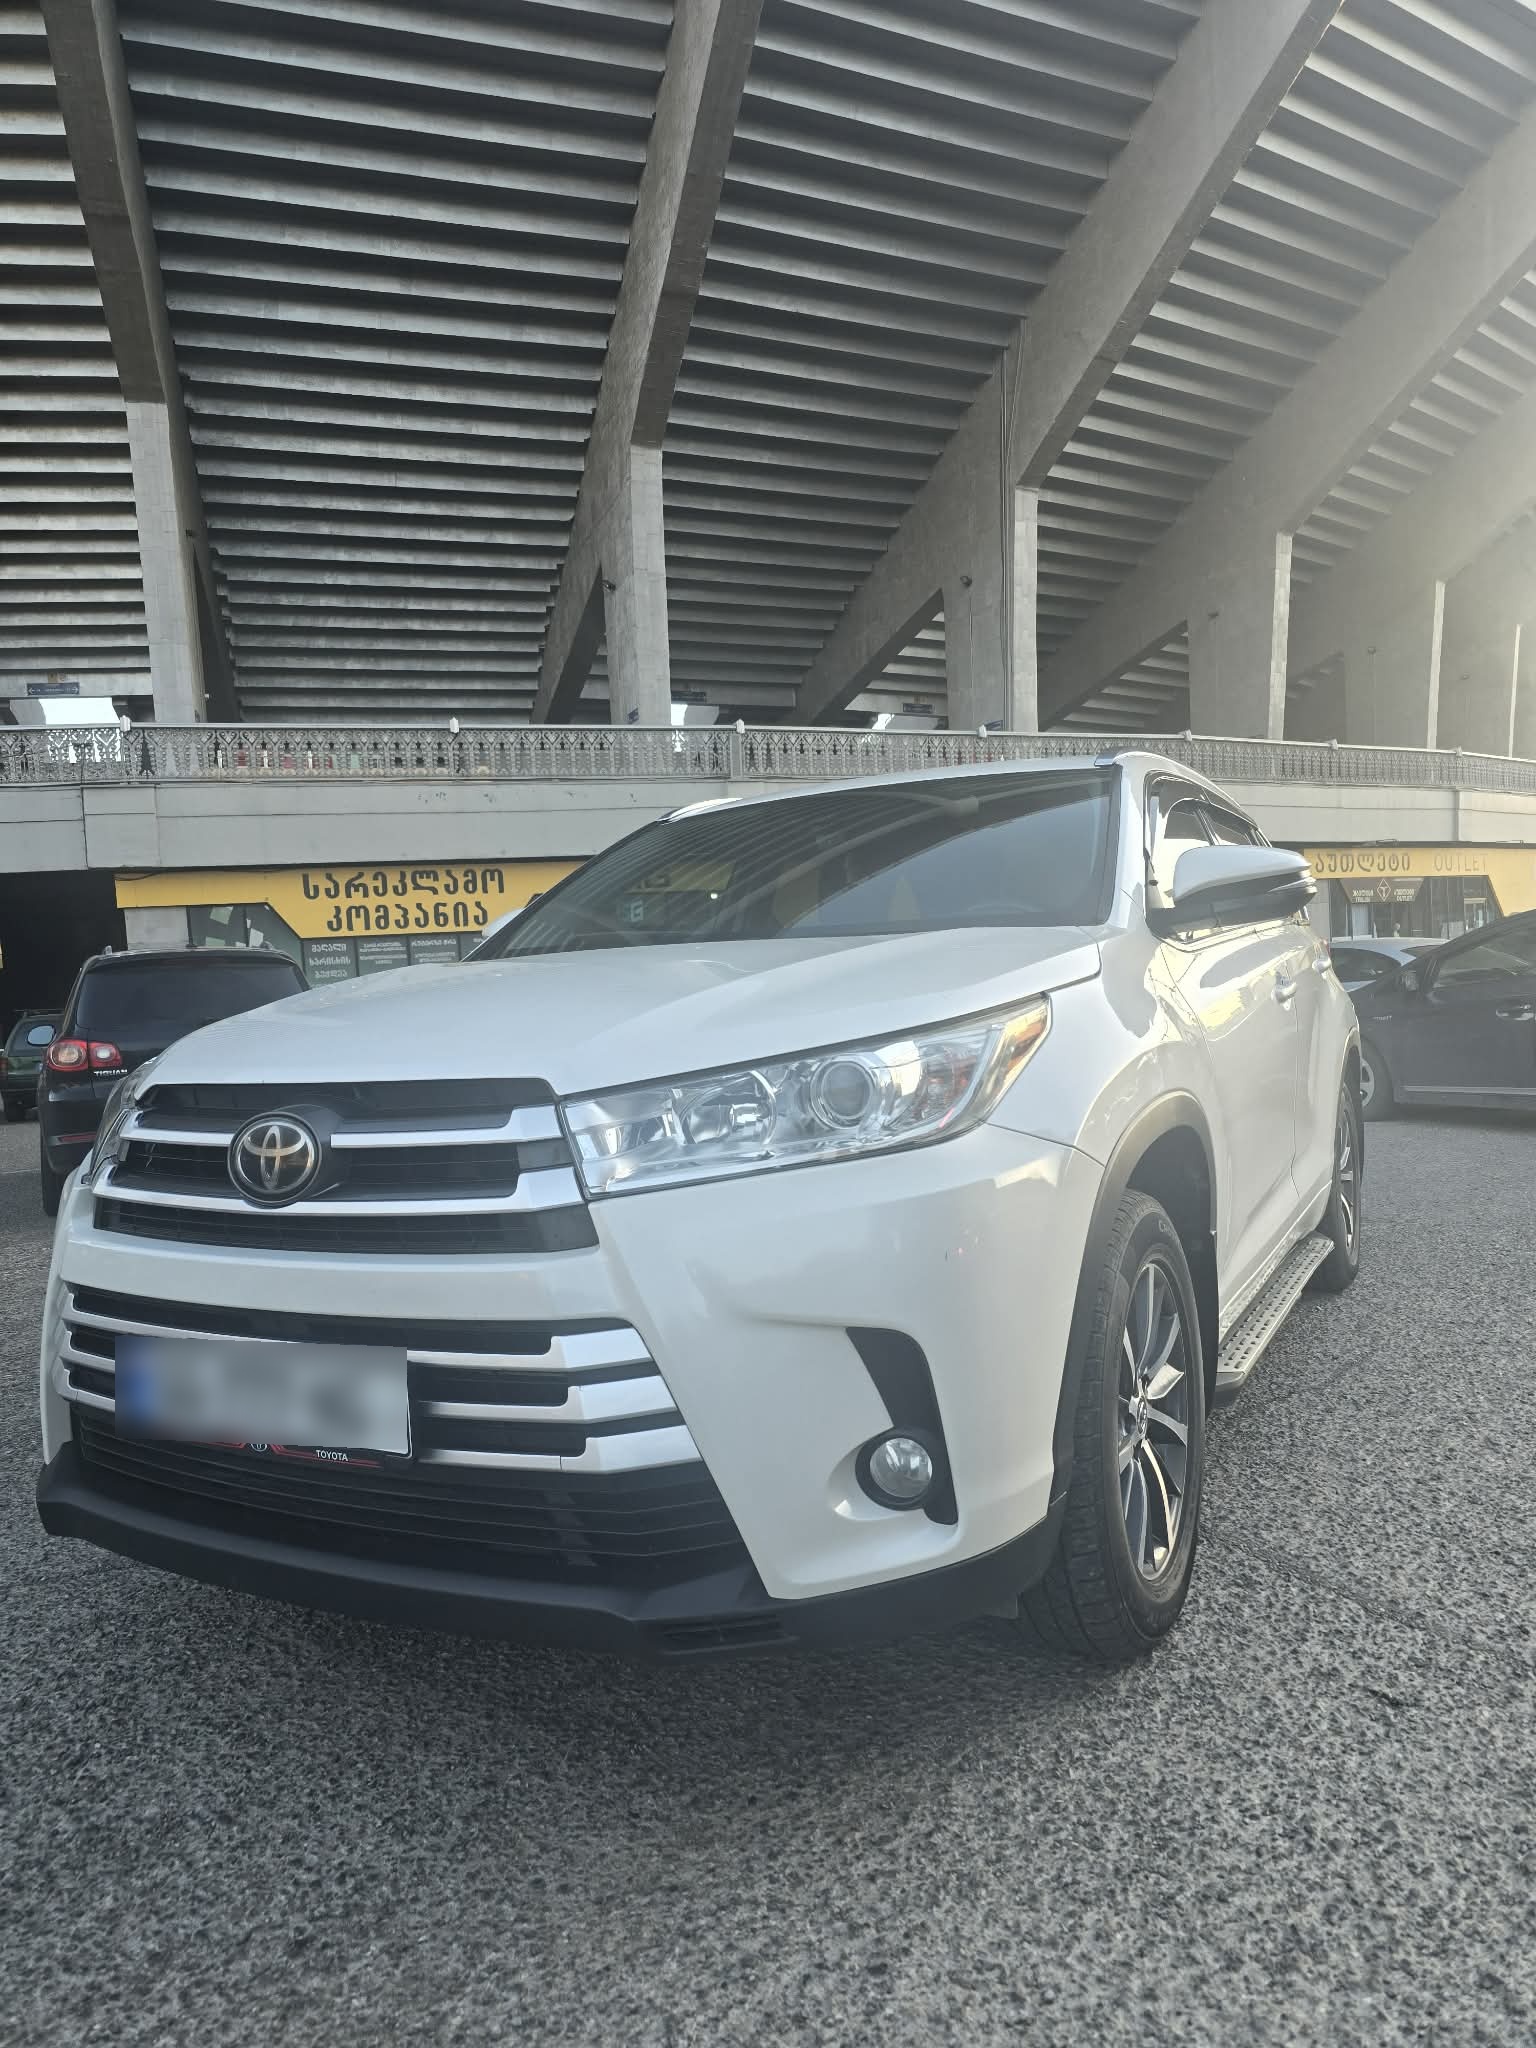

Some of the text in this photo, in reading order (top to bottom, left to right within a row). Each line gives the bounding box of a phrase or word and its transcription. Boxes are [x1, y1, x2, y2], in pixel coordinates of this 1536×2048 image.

[1315, 853, 1410, 873] აუთლეტი
[1433, 854, 1489, 872] OUTLET
[302, 867, 505, 900] სარეკლამო
[326, 901, 489, 932] კომპანია
[311, 943, 347, 953] მაღალი
[316, 1449, 348, 1461] TOYOTA
